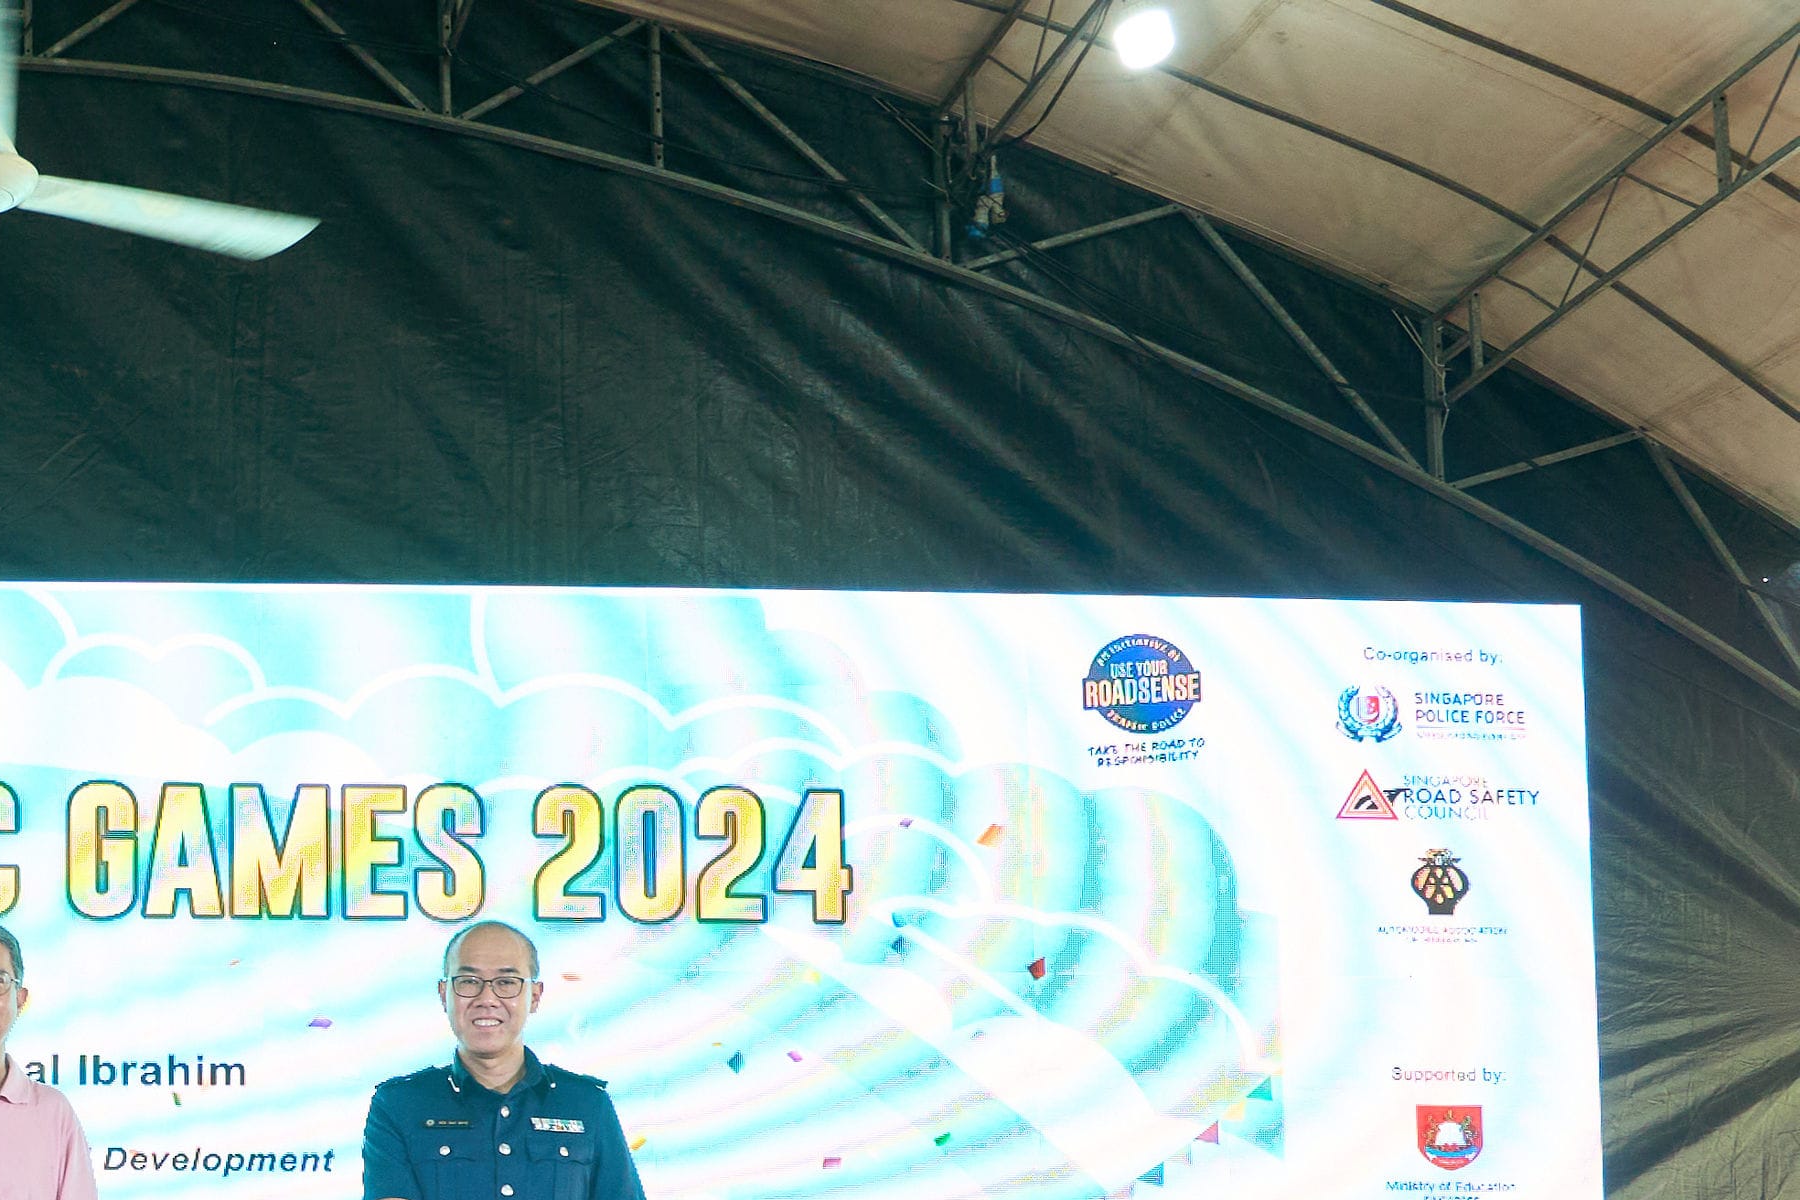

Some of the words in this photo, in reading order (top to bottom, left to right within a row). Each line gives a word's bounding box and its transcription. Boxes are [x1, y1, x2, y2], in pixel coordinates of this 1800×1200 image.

[1363, 647, 1472, 665] Co-organised
[1110, 662, 1134, 679] USE
[1135, 659, 1168, 677] YOUR
[1084, 673, 1199, 708] ROADSENSE
[1415, 692, 1505, 706] SINGAPORE
[1415, 710, 1470, 723] POLICE
[1476, 711, 1525, 724] FORCE
[1088, 745, 1118, 756] TAKE
[1125, 742, 1146, 752] THE
[1152, 739, 1185, 751] ROAD
[1189, 737, 1205, 748] TO
[1403, 775, 1488, 787] SINGAPORE
[1403, 788, 1461, 805] ROAD
[1470, 789, 1539, 805] SAFETY
[1404, 806, 1487, 820] COUNCIL
[67, 780, 486, 922] GAMES
[534, 783, 853, 925] 2024
[79, 1053, 246, 1086] Ibrahim
[1392, 1067, 1476, 1082] Supported
[104, 1147, 335, 1177] Development
